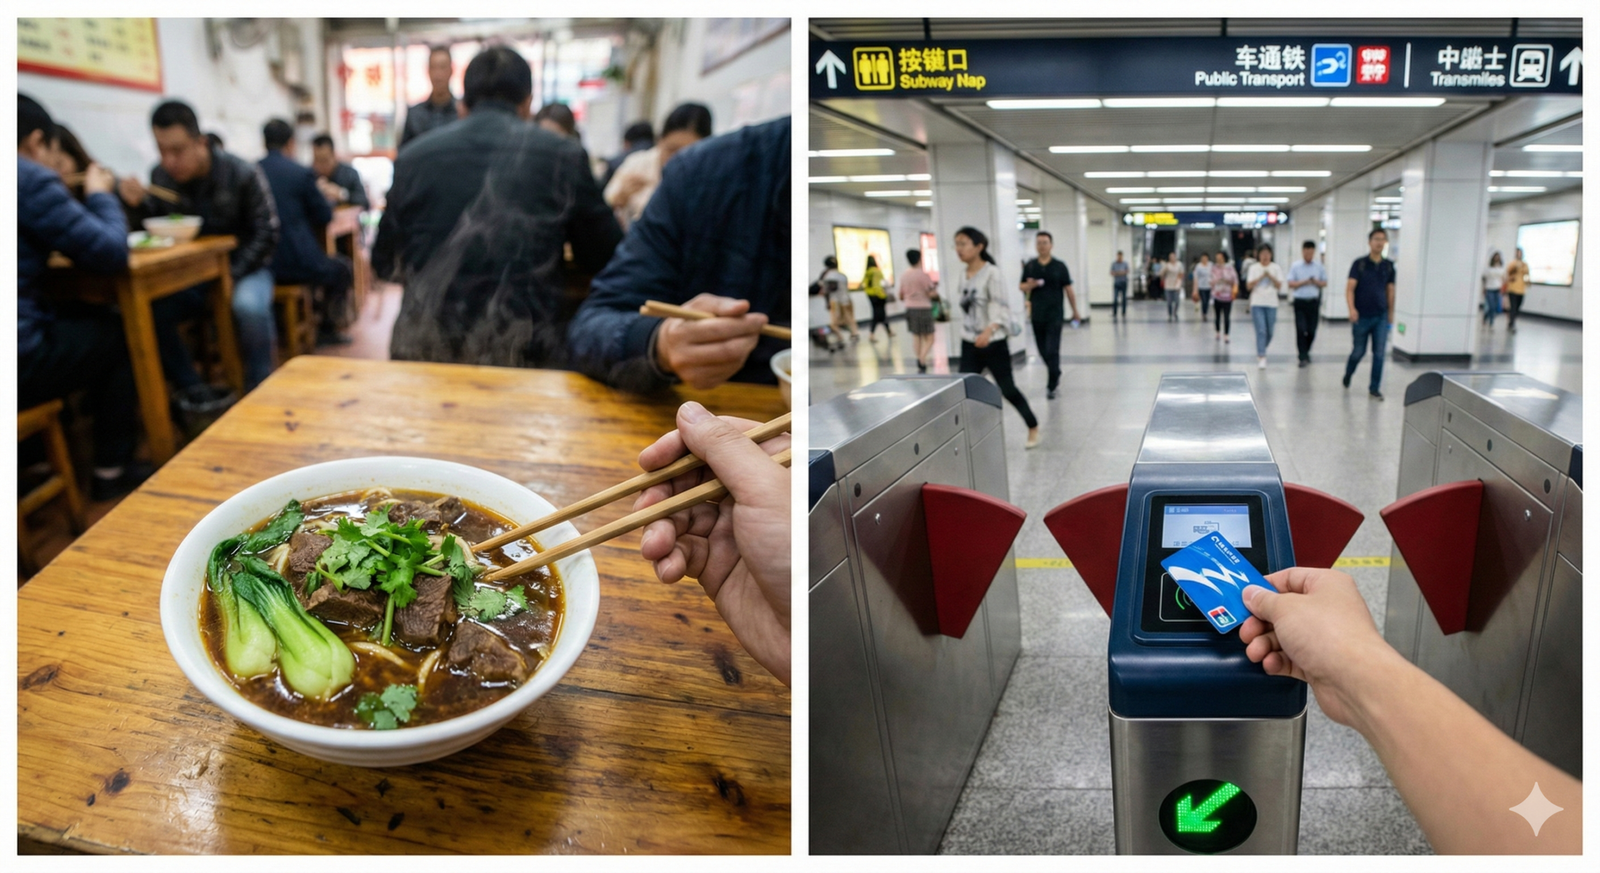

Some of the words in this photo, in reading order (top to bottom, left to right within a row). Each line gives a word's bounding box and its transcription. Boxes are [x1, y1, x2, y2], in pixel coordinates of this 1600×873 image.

[900, 73, 954, 91] Subway
[957, 73, 986, 90] Nap
[1195, 71, 1238, 87] Public
[1239, 71, 1306, 89] Transport
